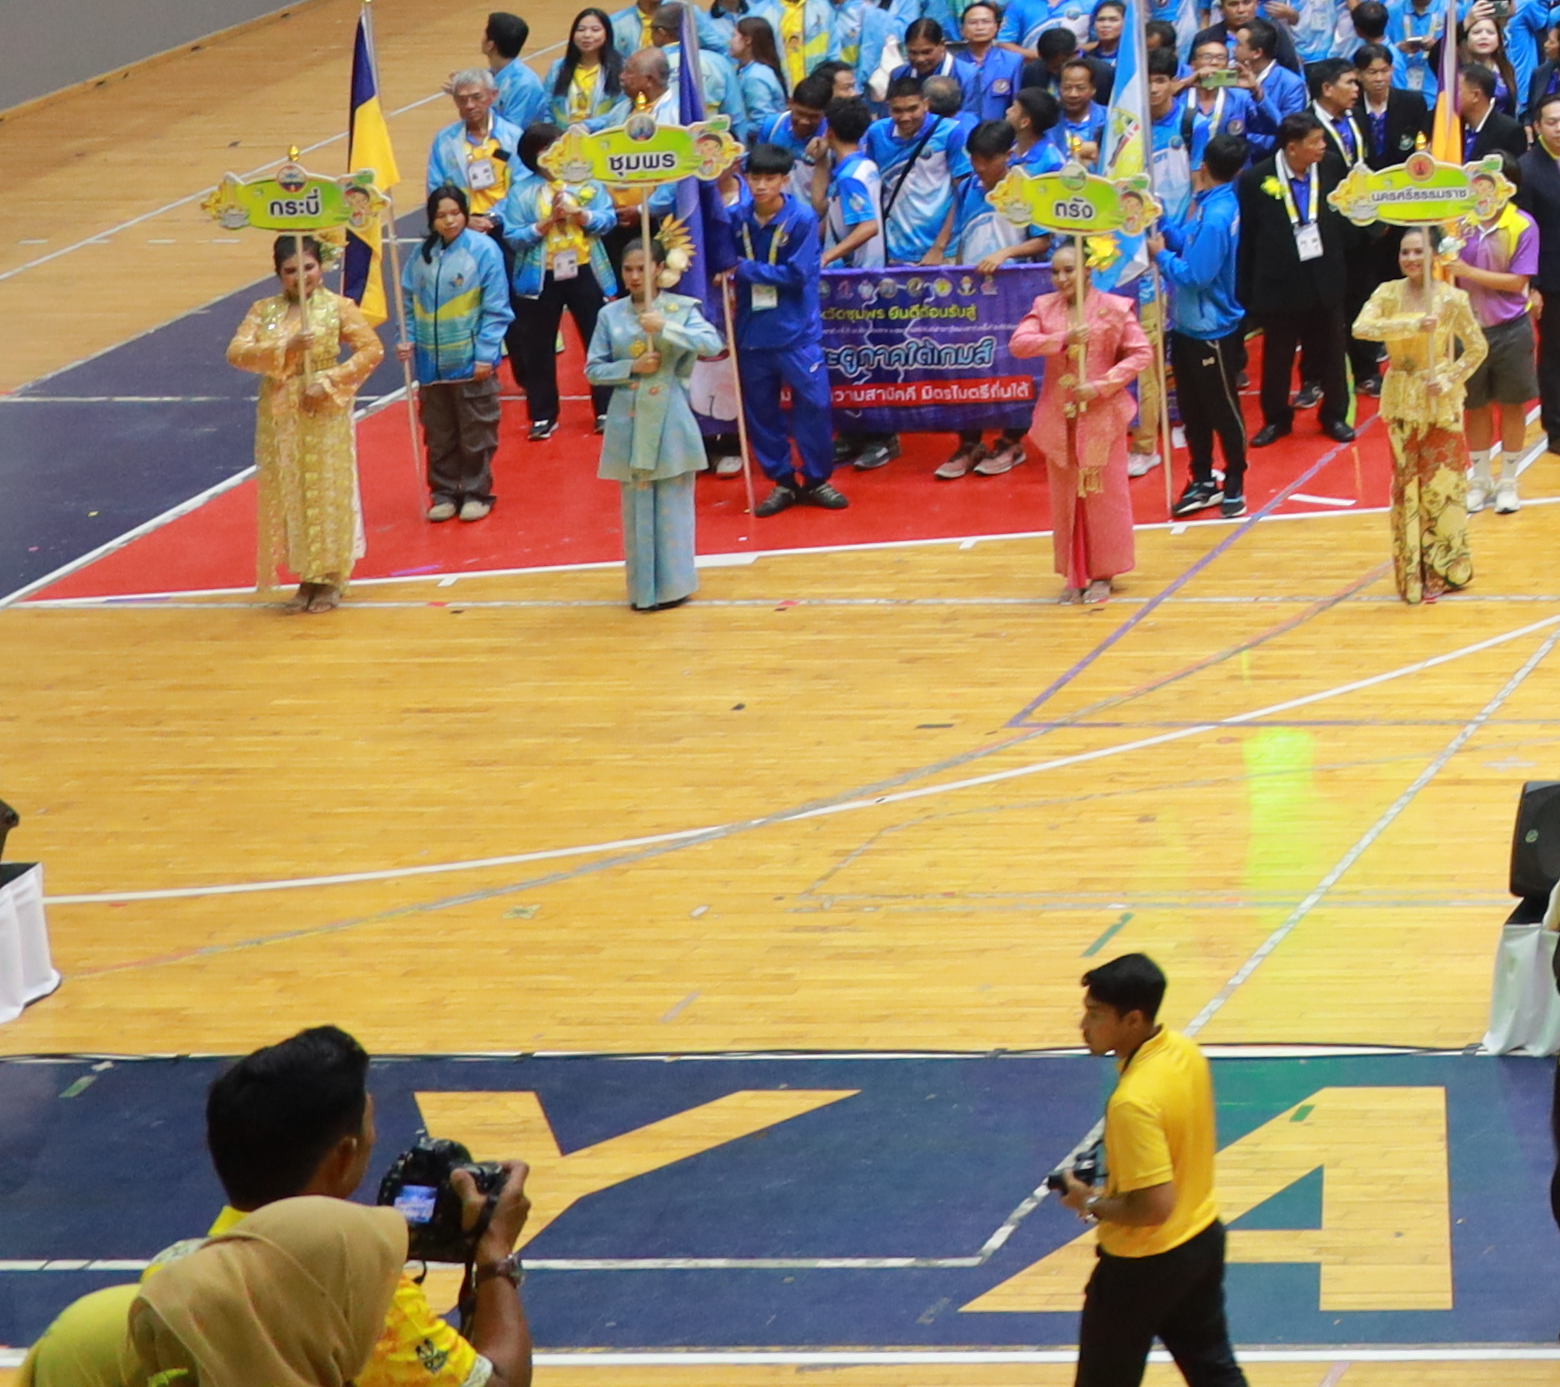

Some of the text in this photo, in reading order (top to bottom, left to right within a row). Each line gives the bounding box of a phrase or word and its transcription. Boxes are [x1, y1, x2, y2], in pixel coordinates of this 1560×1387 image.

[609, 152, 676, 177] ชุมพร
[269, 189, 320, 215] กระบี่
[1371, 187, 1467, 202] นครศรีธรรมราช
[1054, 197, 1093, 219] ตรัง
[825, 338, 994, 375] ะตูภาคใต้เกมส์
